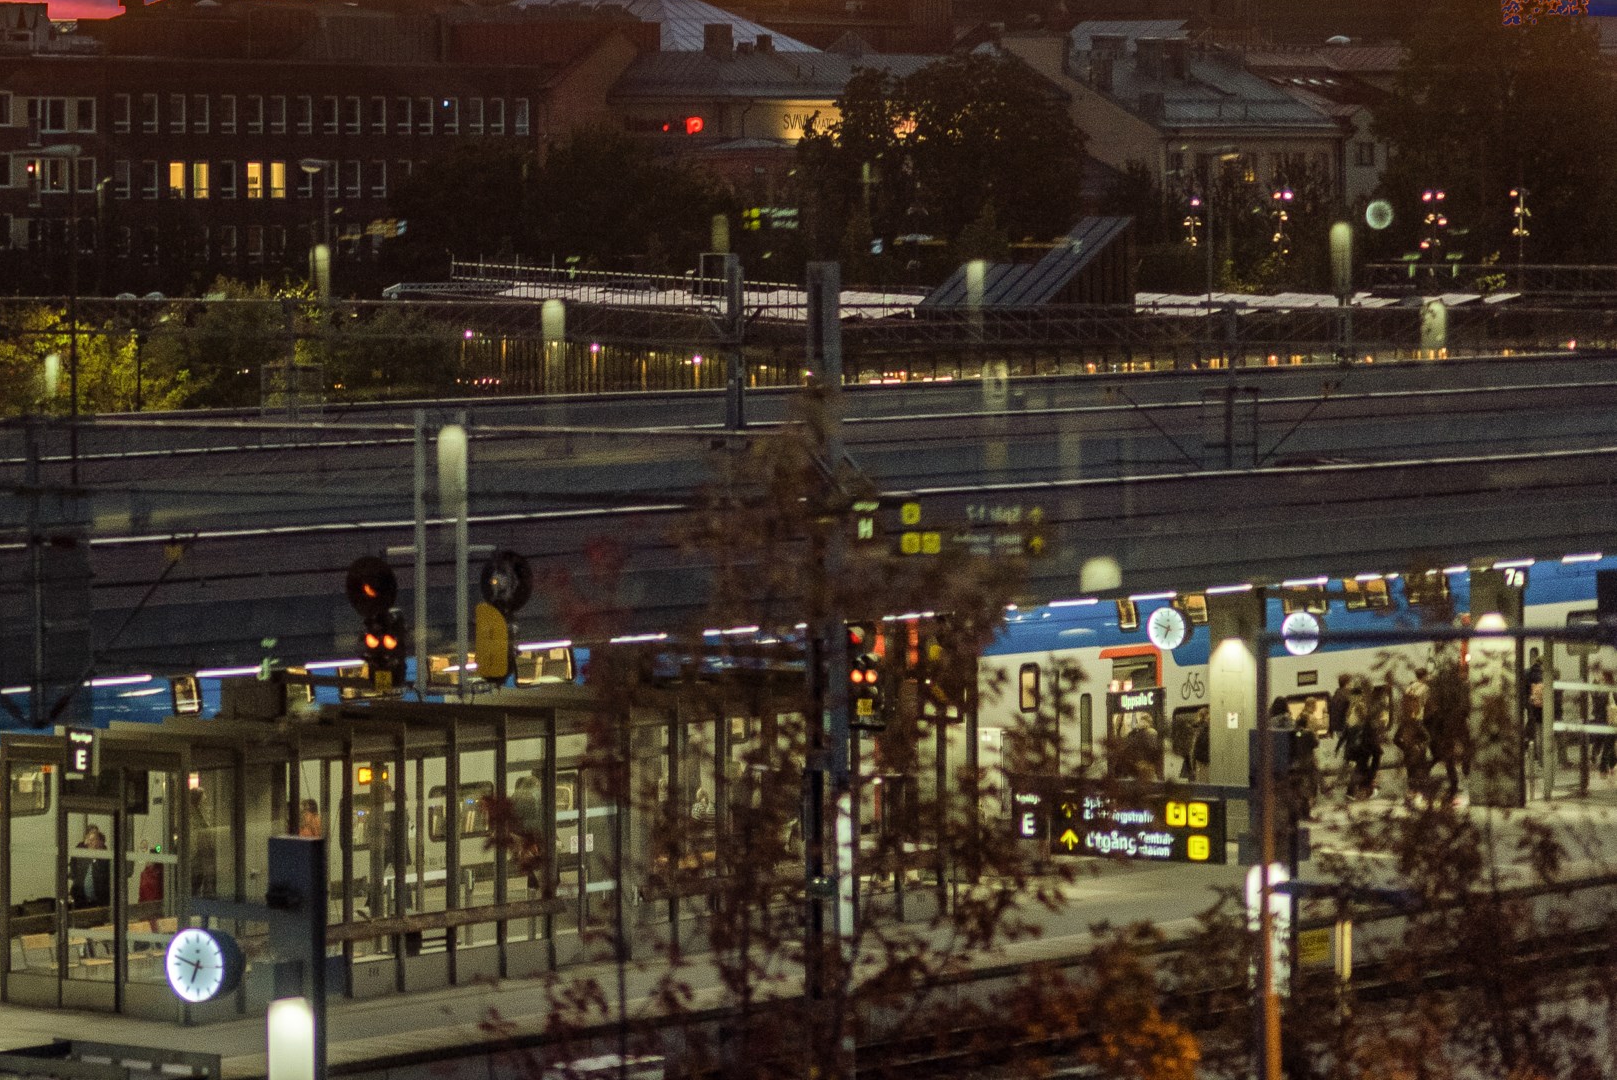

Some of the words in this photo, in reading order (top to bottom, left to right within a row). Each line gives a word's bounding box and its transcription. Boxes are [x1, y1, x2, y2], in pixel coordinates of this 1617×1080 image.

[783, 113, 811, 130] SVAV
[76, 749, 87, 770] E
[1022, 812, 1035, 835] E
